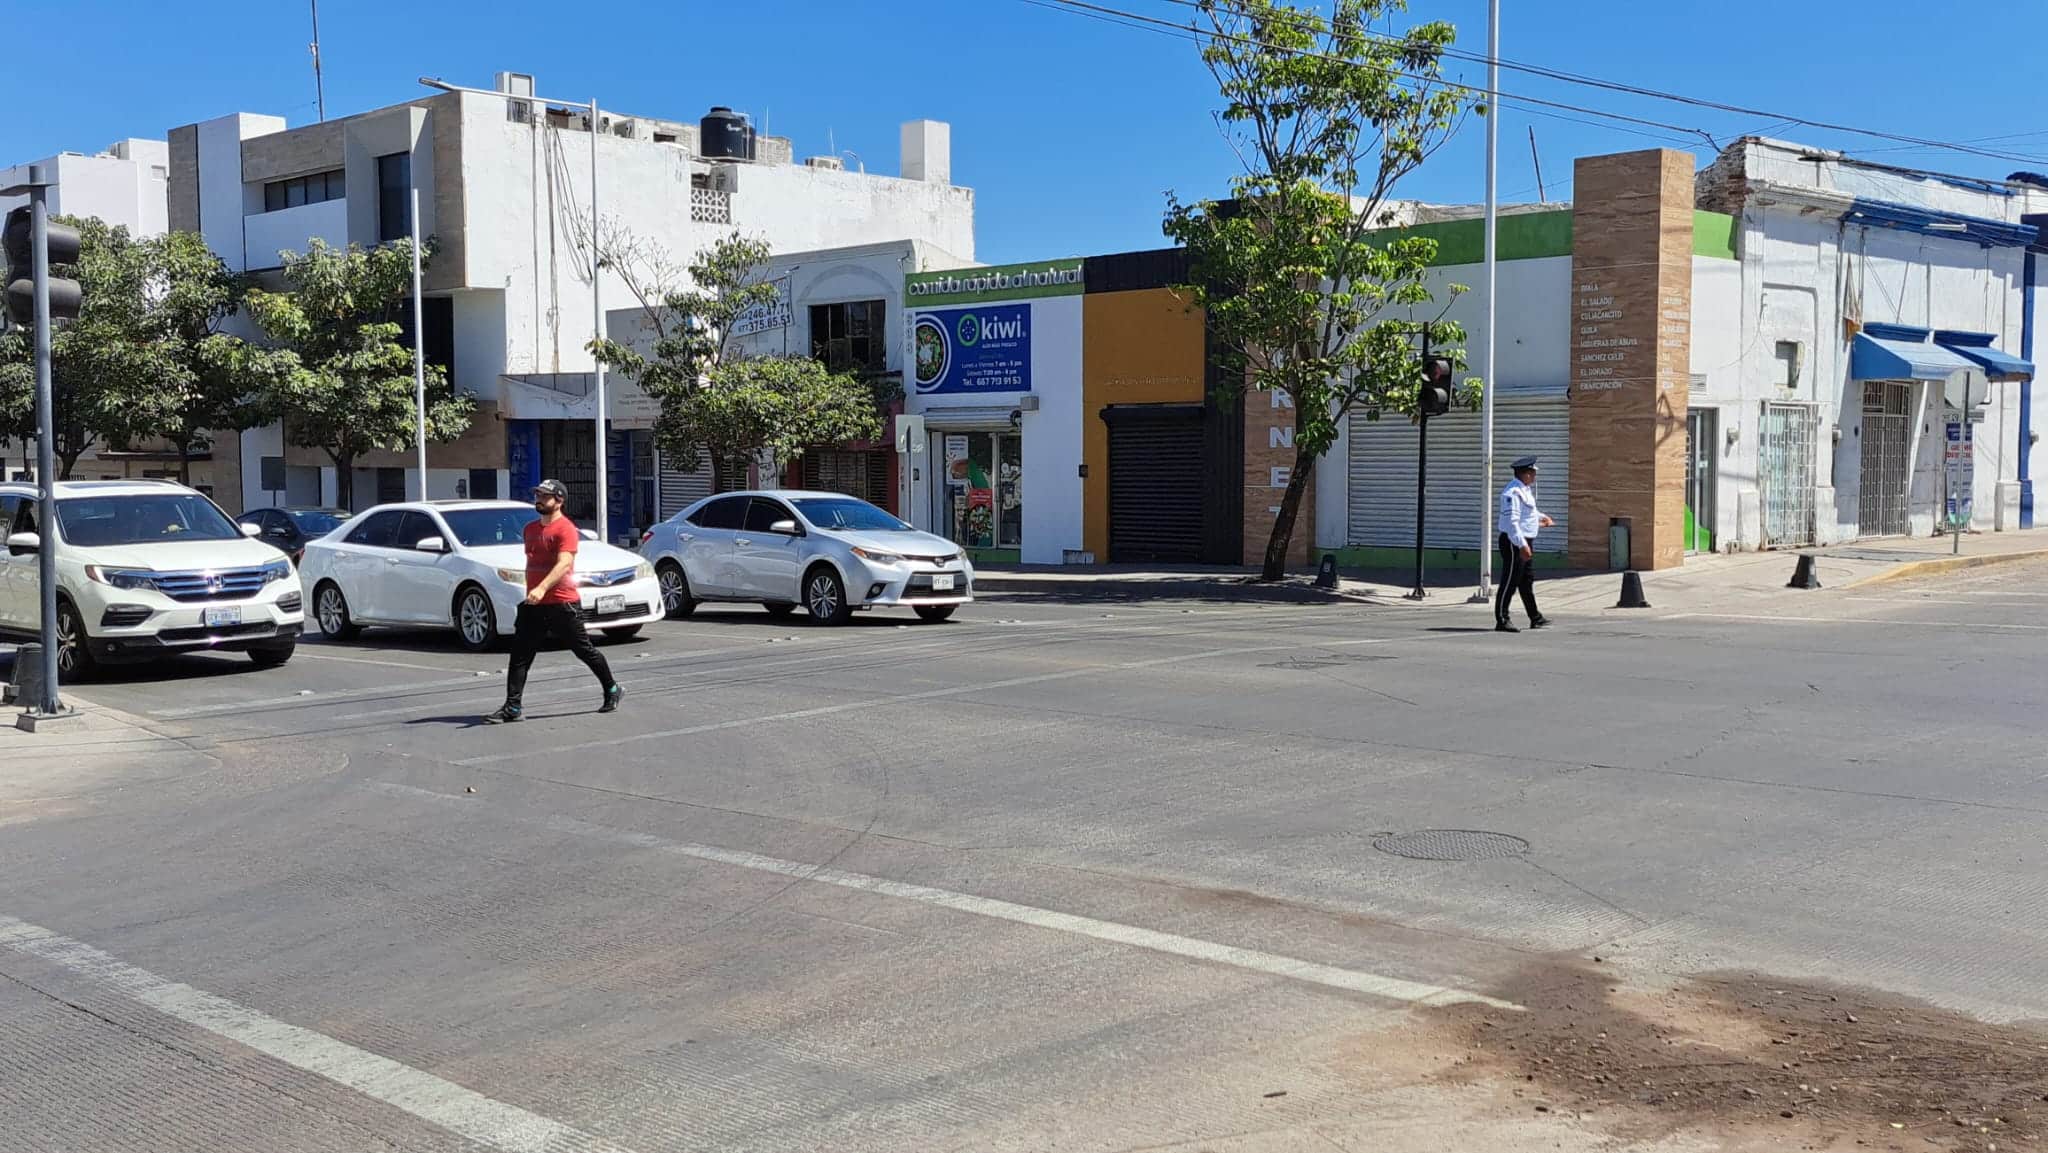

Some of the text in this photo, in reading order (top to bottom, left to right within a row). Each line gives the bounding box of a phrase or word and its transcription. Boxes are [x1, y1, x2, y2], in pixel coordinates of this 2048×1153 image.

[908, 276, 961, 296] comida
[1028, 264, 1083, 286] natural
[981, 314, 1021, 340] kiwi
